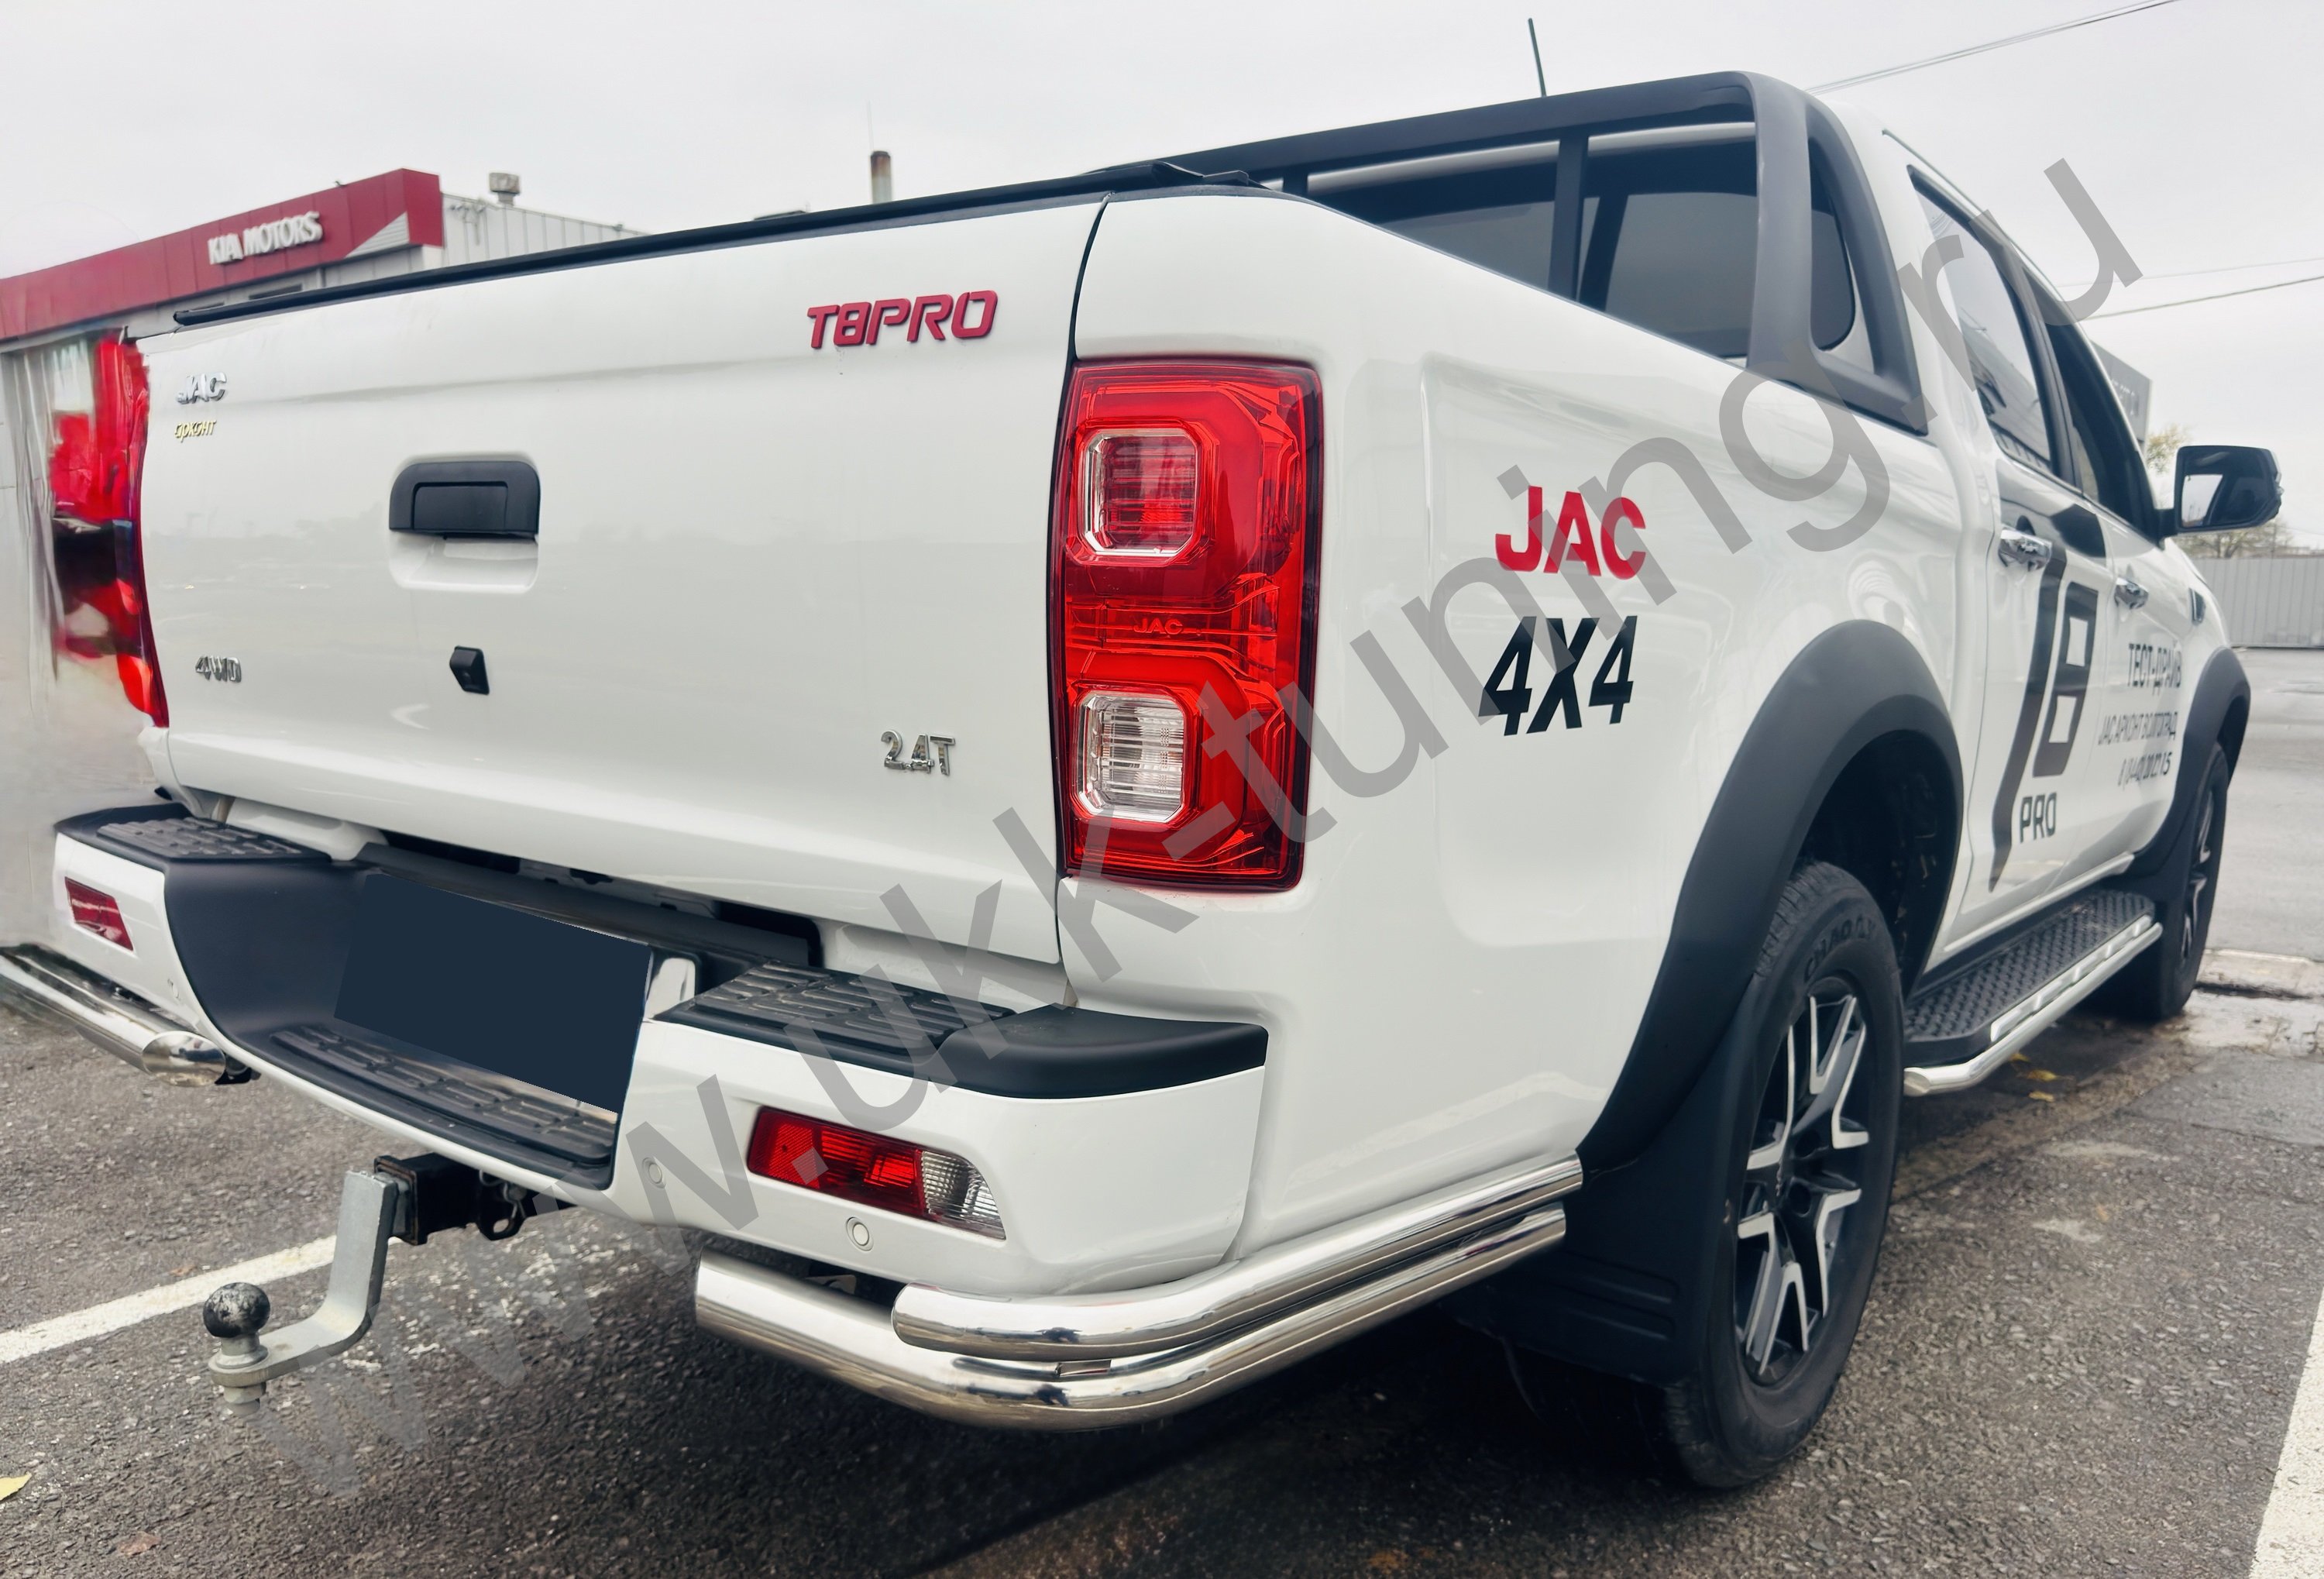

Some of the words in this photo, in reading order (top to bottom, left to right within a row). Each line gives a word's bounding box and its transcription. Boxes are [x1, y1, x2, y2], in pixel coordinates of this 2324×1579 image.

[208, 233, 244, 265] KIA
[243, 211, 323, 256] MOTORS
[807, 290, 998, 349] T8PRO
[176, 372, 227, 404] JAC
[1495, 485, 1646, 580] JAC
[1133, 617, 1183, 635] JAC
[194, 655, 242, 683] 4WD
[1478, 615, 1638, 736] 4X4
[2019, 792, 2057, 844] PRO
